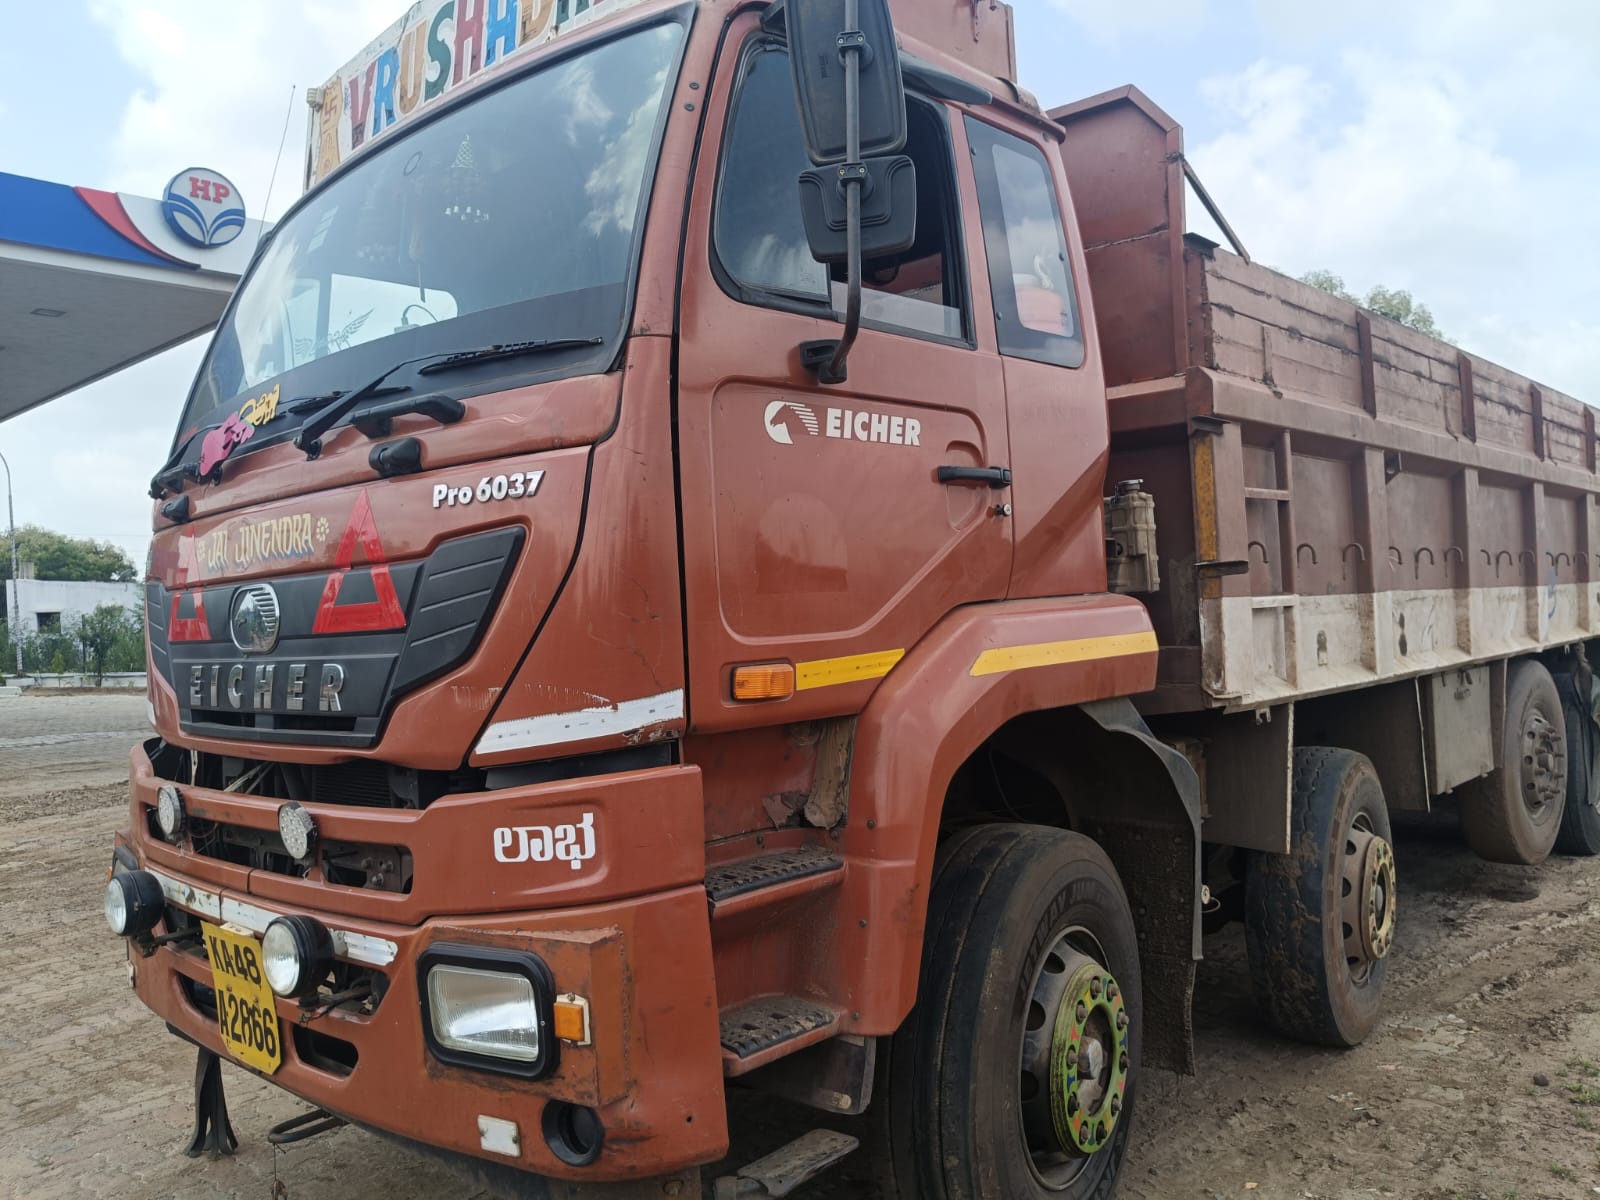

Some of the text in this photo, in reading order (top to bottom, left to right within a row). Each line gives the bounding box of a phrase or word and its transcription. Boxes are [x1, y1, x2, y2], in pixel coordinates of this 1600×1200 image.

[189, 176, 230, 204] HP
[826, 407, 921, 446] EICHER
[433, 470, 545, 508] Pro 6037
[207, 513, 315, 571] JAI JINENDRA
[190, 663, 344, 712] EICHER
[493, 812, 596, 870] ಲಾಭ
